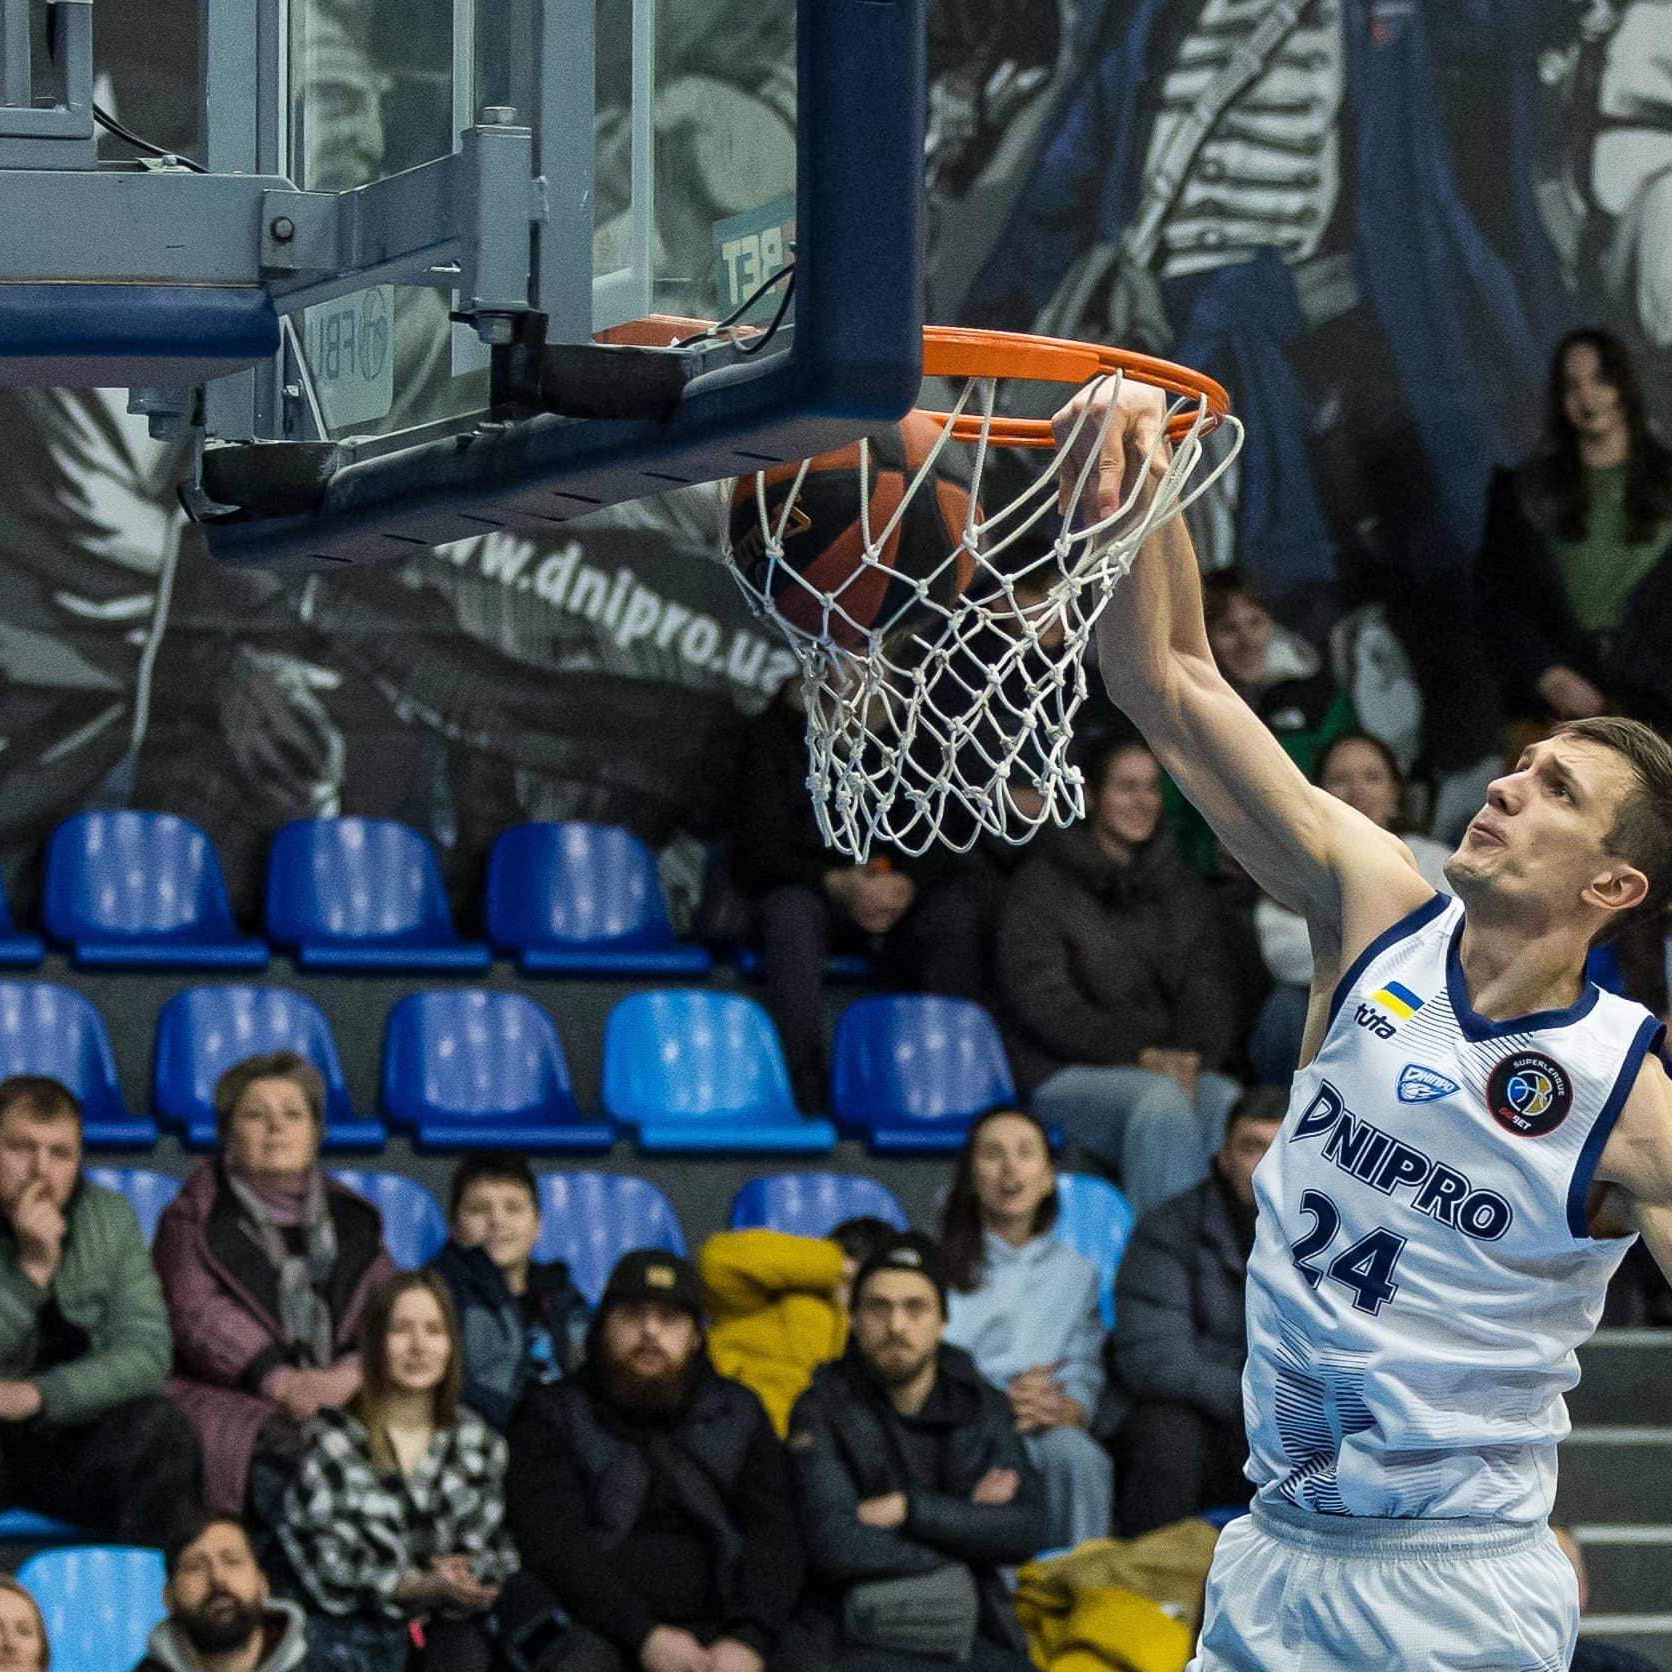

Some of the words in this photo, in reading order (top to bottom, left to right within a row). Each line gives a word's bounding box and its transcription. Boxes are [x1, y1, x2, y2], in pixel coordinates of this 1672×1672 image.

[1513, 1058, 1565, 1097] SUPERLEAGUE
[1289, 1078, 1514, 1242] DNIPRO
[1291, 1188, 1409, 1317] 24
